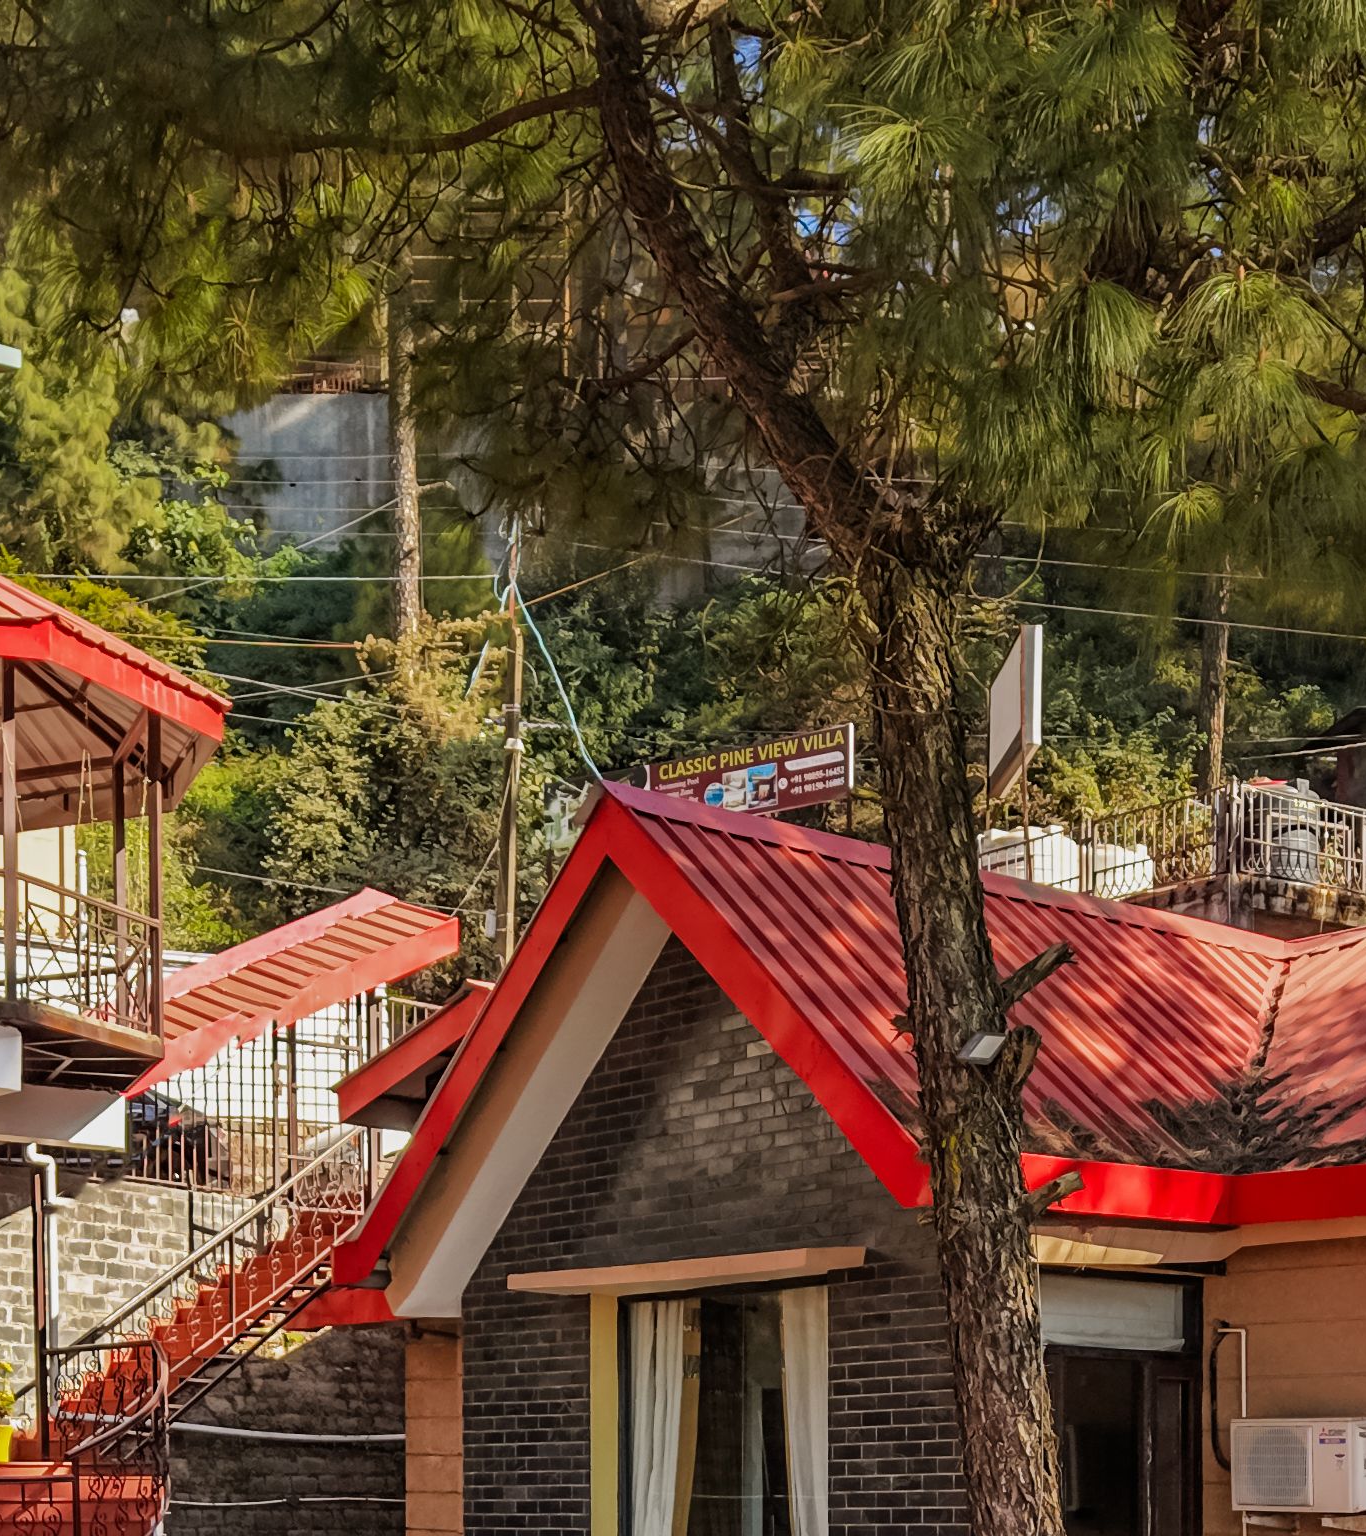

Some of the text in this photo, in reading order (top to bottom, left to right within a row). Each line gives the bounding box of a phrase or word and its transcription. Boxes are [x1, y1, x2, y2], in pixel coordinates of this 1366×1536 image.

[658, 754, 717, 780] CLASSIC
[720, 747, 754, 769] PINE
[758, 737, 799, 761] VIEW
[801, 729, 845, 752] VILLA
